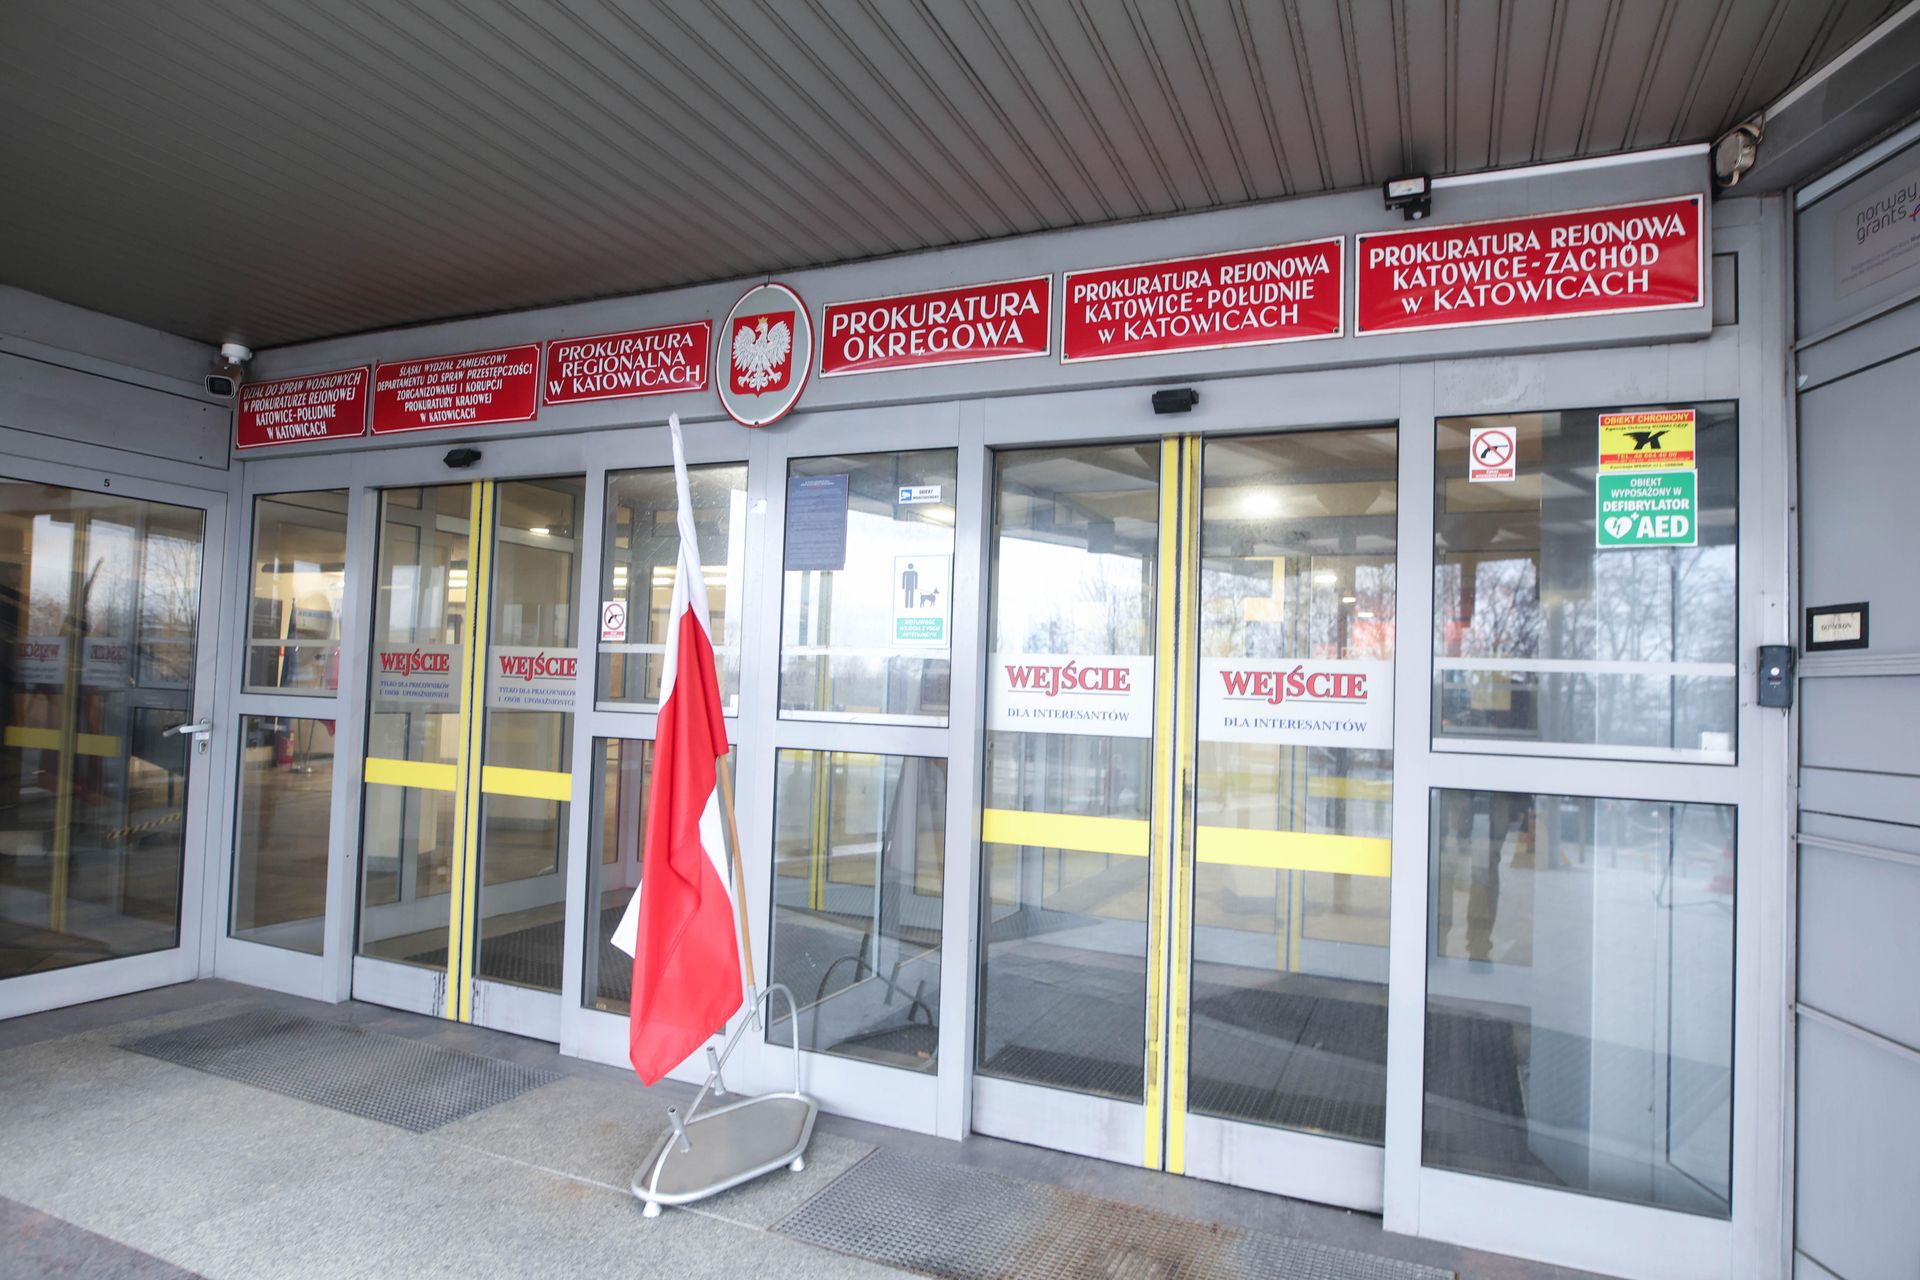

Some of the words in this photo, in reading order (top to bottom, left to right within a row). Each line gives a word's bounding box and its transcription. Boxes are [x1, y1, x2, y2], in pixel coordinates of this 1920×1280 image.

[1856, 182, 1917, 226] norway
[1857, 205, 1907, 245] grants
[1369, 229, 1541, 270] PROKURATURA
[1550, 213, 1686, 248] REJONOWA
[1073, 268, 1212, 304] PROKURATURA
[1220, 253, 1330, 286] REJONOWA
[1434, 268, 1649, 311] KATOWICACH
[832, 289, 1040, 338] PROKURATURA
[1124, 304, 1299, 342] KATOWICACH
[558, 331, 694, 363] PROKURATURA
[843, 318, 1024, 362] OKRĘGOWA
[376, 375, 425, 392] DEPARTAMENTU
[427, 373, 439, 384] DO
[440, 370, 464, 383] SPRAW
[466, 362, 533, 380] PRZESTĘPCZOŚCI
[399, 364, 422, 377] ŚLĄSKI
[424, 361, 454, 373] WYDZIAŁ
[456, 353, 508, 369] ZAMIEJSCOWY
[562, 349, 686, 378] REGIONALNA
[265, 384, 278, 397] DO
[279, 380, 306, 394] SPRAW
[305, 372, 362, 390] WOJSKOWYCH
[396, 384, 458, 401] ZORGANIZOWANEJ
[466, 379, 503, 393] KORUPCJI
[549, 379, 565, 396] W
[573, 364, 700, 394] KATOWICACH
[243, 401, 250, 413] W
[250, 392, 307, 413] PROKURATURZE
[308, 387, 356, 405] REJONOWEJ
[404, 398, 453, 412] PROKURATURY
[455, 393, 493, 407] KRAJOWEJ
[255, 404, 337, 427] KATOWICE-POŁUDNIE
[420, 413, 427, 423] W
[429, 408, 476, 423] KATOWICACH
[1604, 415, 1636, 425] OBIEKT
[1637, 413, 1689, 423] CHRONIONY
[266, 427, 274, 440] W
[275, 421, 327, 440] KATOWICACH
[104, 478, 110, 487] 5
[1610, 486, 1672, 498] WYPOSAŻONY
[1673, 487, 1682, 496] W
[1630, 477, 1662, 487] OBIEKT
[1603, 498, 1690, 512] DEFIBRYLATOR
[1636, 515, 1689, 539] AED
[379, 648, 450, 677] WEJŚCIE
[499, 652, 577, 682] WEJŚCIE
[1004, 660, 1131, 697] WEJŚCIE
[1219, 664, 1368, 705] WEJŚCIE
[1008, 708, 1030, 718] DLA
[1033, 708, 1130, 721] INTERESANTÓW
[1224, 717, 1250, 727] DLA
[1254, 718, 1367, 732] INTERESANTÓW
